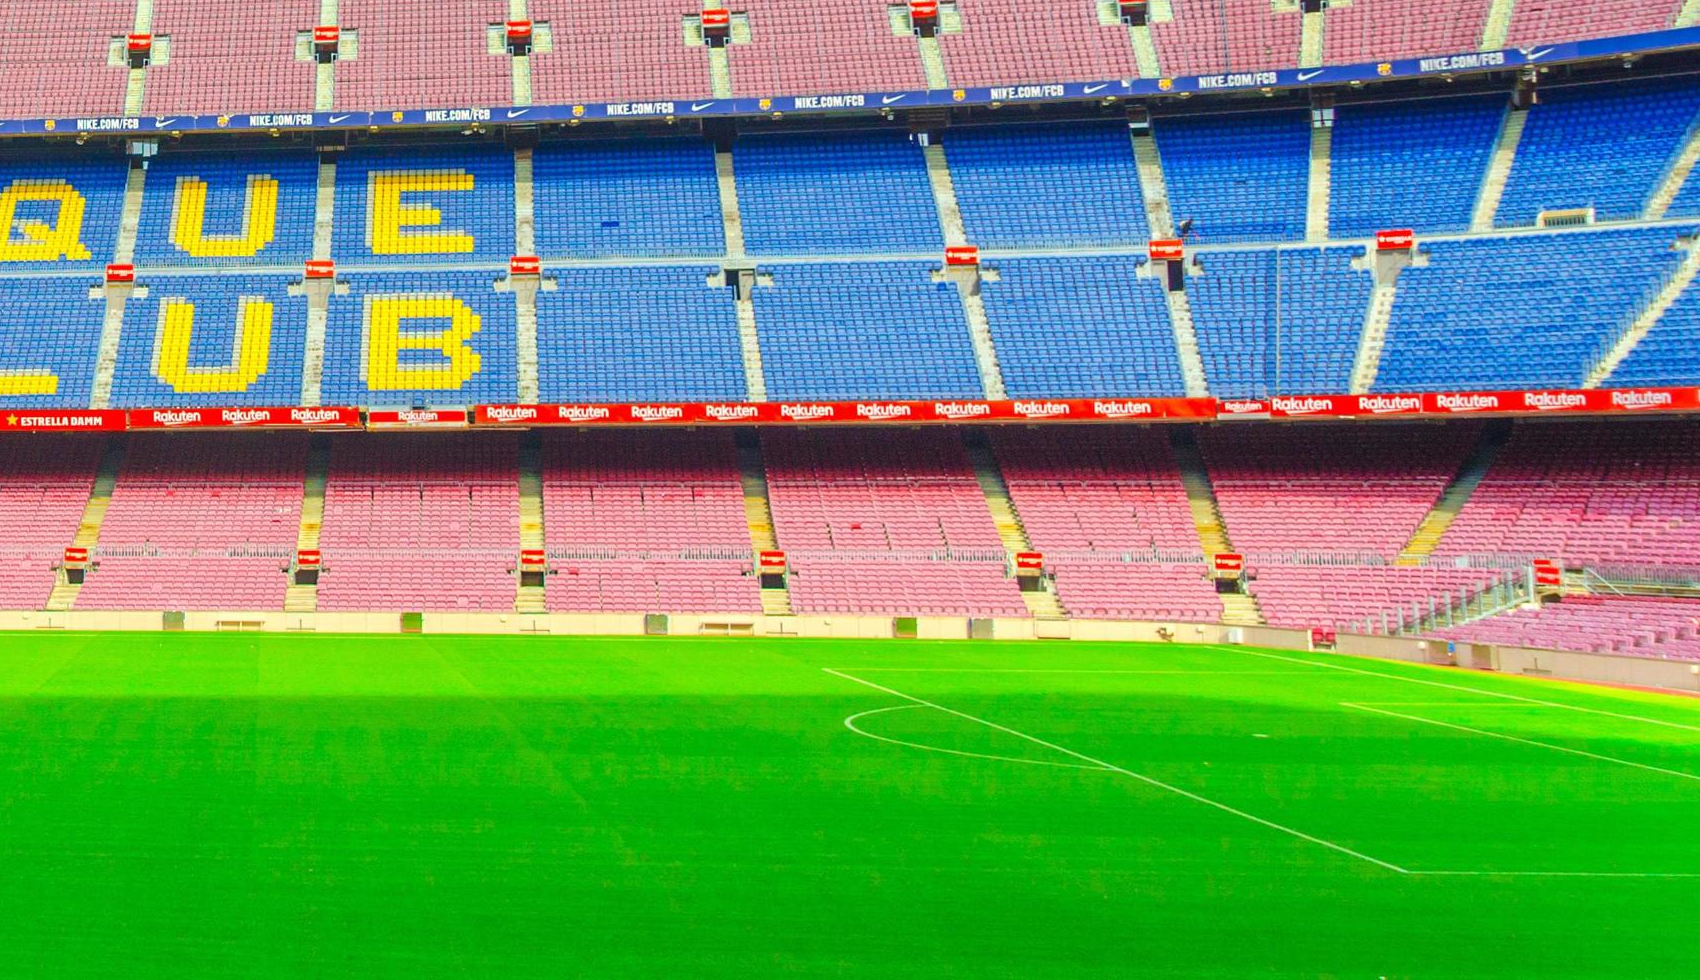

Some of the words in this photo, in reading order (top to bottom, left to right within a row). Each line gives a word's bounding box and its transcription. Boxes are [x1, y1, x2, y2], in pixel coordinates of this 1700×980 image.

[1270, 398, 1332, 414] Rakuten
[1359, 398, 1419, 413] Rakuten
[1437, 395, 1498, 411] Rakuten
[1525, 393, 1585, 410] Rakuten
[1613, 391, 1671, 409] Rakuten
[292, 409, 339, 423] Rakuten
[398, 410, 439, 423] Rakuten
[487, 407, 536, 421] Rakuten
[559, 406, 609, 421] Rakuten
[632, 406, 682, 420] Rakuten
[706, 405, 757, 420] Rakuten
[781, 404, 833, 419] Rakuten
[857, 404, 910, 419] Rakuten
[936, 403, 989, 418] Rakuten
[1014, 401, 1069, 417] Rakuten
[1095, 402, 1151, 417] Rakuten
[20, 416, 68, 427] ESTRELLA
[70, 416, 103, 427] DAMM
[154, 411, 200, 425] Rakuten
[223, 410, 269, 424] Rakuten
